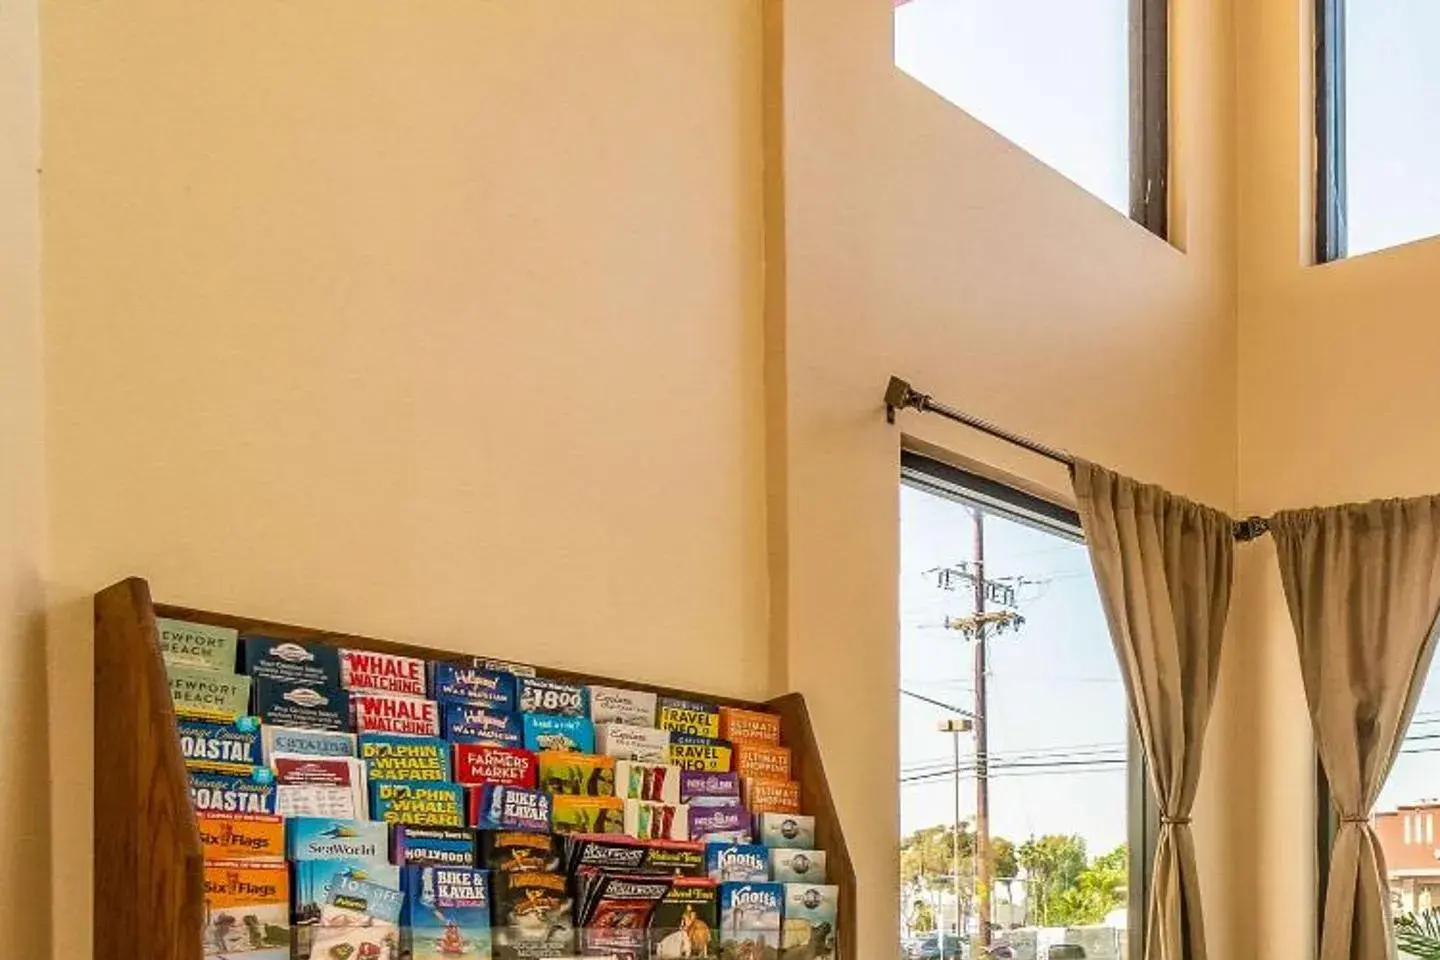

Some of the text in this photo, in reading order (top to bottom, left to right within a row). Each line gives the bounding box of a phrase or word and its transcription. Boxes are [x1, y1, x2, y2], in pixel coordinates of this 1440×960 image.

[162, 631, 227, 649] EWPORT
[350, 655, 420, 680] WHALE
[350, 673, 422, 694] WATCHING
[174, 690, 225, 705] BEACH
[363, 697, 433, 721] WHALE
[663, 708, 712, 727] TRAVEL
[363, 714, 435, 735] WATCHING
[181, 736, 254, 763] OASTAL
[364, 744, 437, 758] DOLPHIN
[670, 743, 718, 759] TRAVEL
[375, 758, 440, 769] WHALE
[468, 752, 529, 769] FARMERS
[370, 769, 444, 781] SAFARI
[471, 766, 527, 780] MARKET
[380, 784, 456, 801] DOLPHIN
[506, 790, 548, 809] BIKE &
[394, 801, 457, 814] WHALE
[505, 804, 548, 822] KAYAK
[232, 833, 270, 849] Flags
[309, 842, 376, 857] SeaWorld
[437, 871, 483, 886] BIKE &
[203, 880, 277, 897] Six Flags
[438, 886, 485, 900] KAYAK
